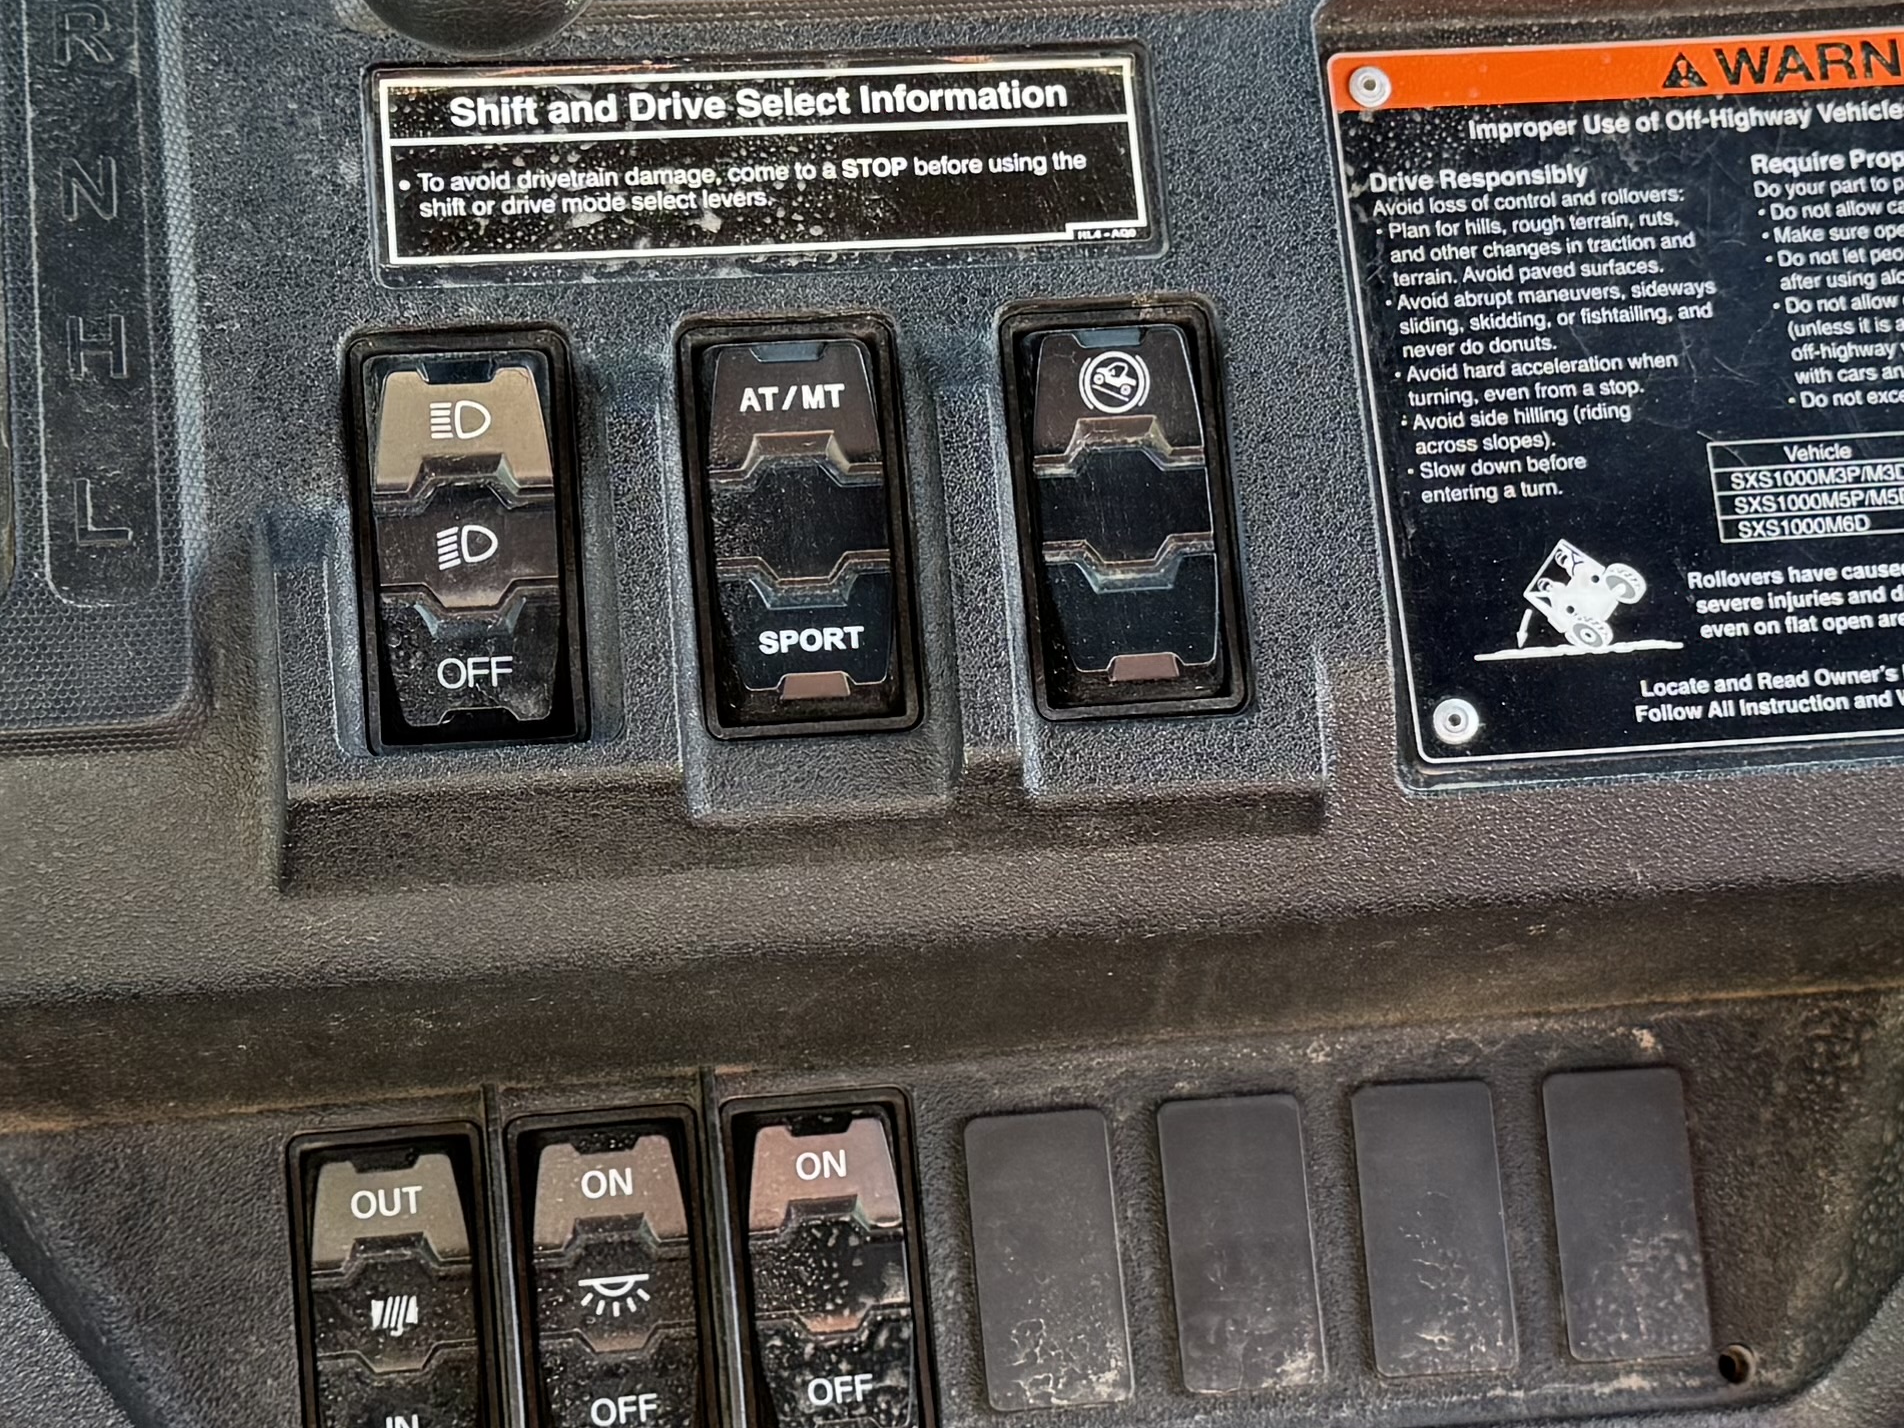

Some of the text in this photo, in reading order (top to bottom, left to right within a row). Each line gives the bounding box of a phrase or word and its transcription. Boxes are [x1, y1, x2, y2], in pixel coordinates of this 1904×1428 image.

[53, 1, 110, 63] R
[450, 78, 1067, 128] Shift and Drive Select Information
[1469, 118, 1577, 142] Improper
[1583, 112, 1629, 133] Use
[1636, 109, 1660, 130] of
[1666, 104, 1812, 130] Off-Highway
[418, 149, 1086, 192] To avoid drivetrain damage, come to a STOP before using the
[1370, 165, 1588, 192] Drive Responsibly
[1750, 151, 1845, 178] Require
[62, 156, 118, 222] N
[420, 187, 772, 217] shift or drive mode select levers.
[1373, 187, 1685, 217] Avoid loss of control and rollovers:
[1388, 210, 1679, 240] Plan for hills, rough terrain, ruts,
[67, 314, 127, 380] H
[1784, 443, 1852, 463] Vehicle
[76, 478, 133, 547] L
[1738, 515, 1871, 539] SXS1000M6D
[1688, 570, 1783, 590] Rollovers
[1788, 566, 1836, 584] have
[1696, 597, 1763, 614] severe
[1768, 589, 1844, 613] injuries
[1849, 586, 1887, 605] and
[757, 625, 865, 656] SPORT
[1700, 623, 1749, 639] even
[1755, 621, 1781, 636] on
[1786, 616, 1818, 634] flat
[1823, 616, 1874, 635] open
[436, 655, 514, 690] OFF
[1641, 677, 1709, 697] Locate
[1715, 673, 1752, 693] and
[1758, 669, 1809, 690] Read
[1815, 665, 1897, 687] Owner's
[1635, 702, 1703, 722] Follow
[1708, 699, 1735, 718] All
[1740, 693, 1849, 716] Instruction
[1854, 690, 1892, 709] and
[795, 1150, 848, 1181] ON
[581, 1167, 634, 1199] ON
[350, 1185, 422, 1220] OUT
[807, 1372, 873, 1406] OFF
[590, 1394, 658, 1426] OFF
